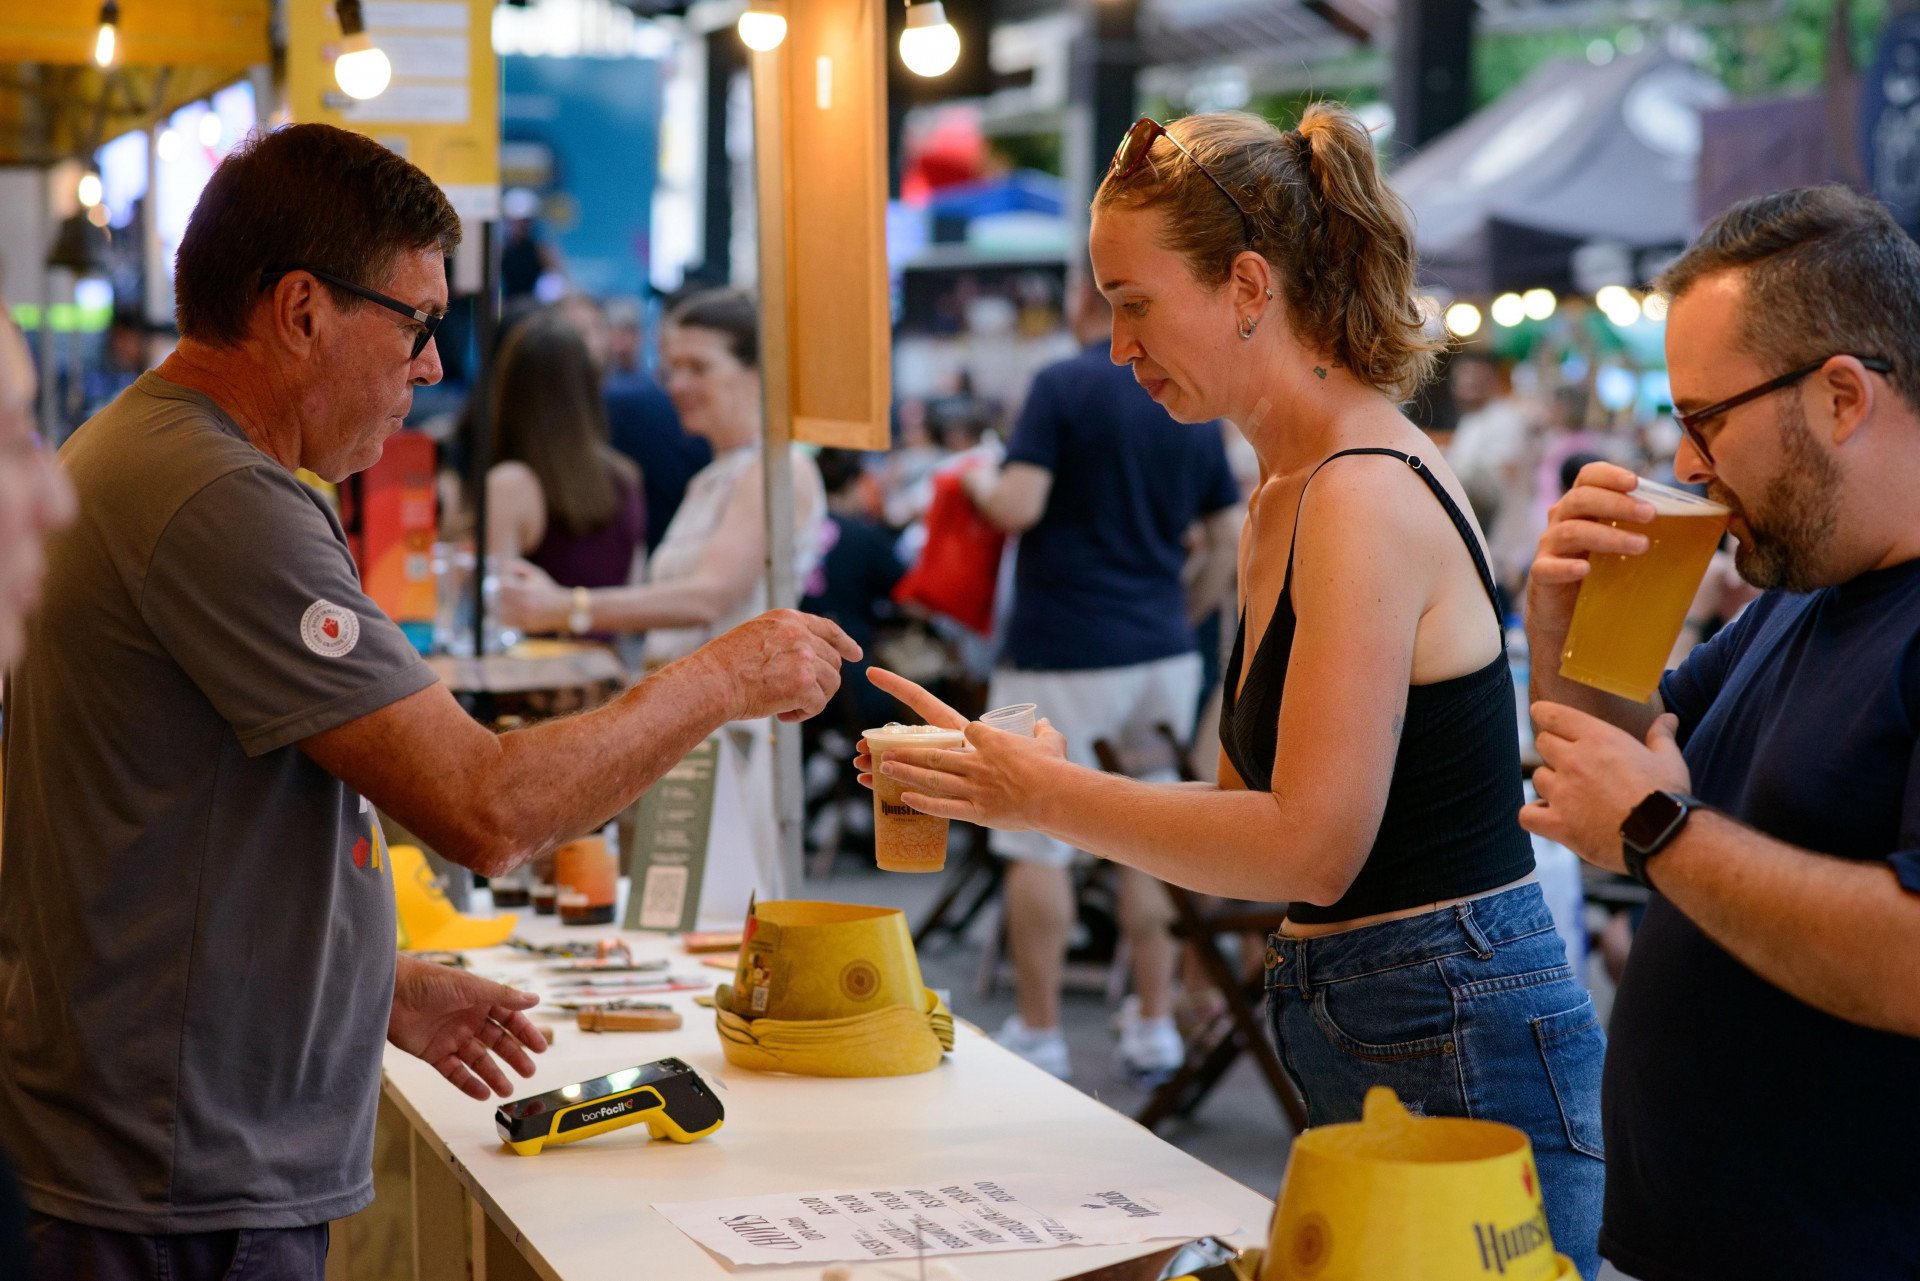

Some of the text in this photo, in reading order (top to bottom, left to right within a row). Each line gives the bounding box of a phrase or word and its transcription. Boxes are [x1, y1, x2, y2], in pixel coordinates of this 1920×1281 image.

[881, 800, 929, 816] Hunsr
[717, 1213, 802, 1250] CHOPES
[1472, 1206, 1548, 1275] Huns
